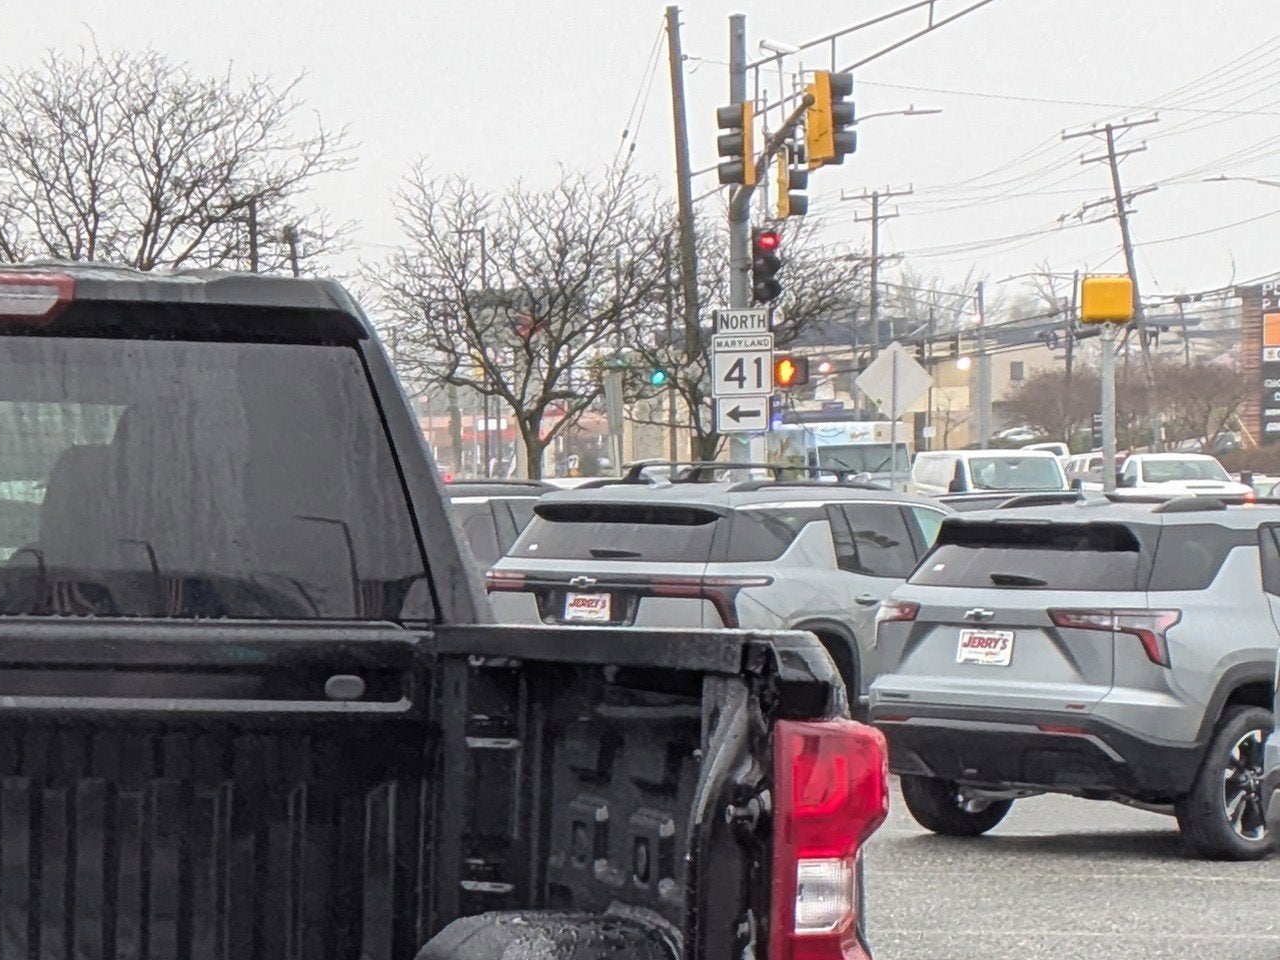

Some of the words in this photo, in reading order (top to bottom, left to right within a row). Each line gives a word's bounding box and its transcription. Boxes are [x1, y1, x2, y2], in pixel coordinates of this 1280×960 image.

[719, 314, 766, 330] NORTH
[716, 339, 769, 349] MARYLAND
[723, 357, 763, 390] 41
[961, 635, 1010, 651] JERRY'S
